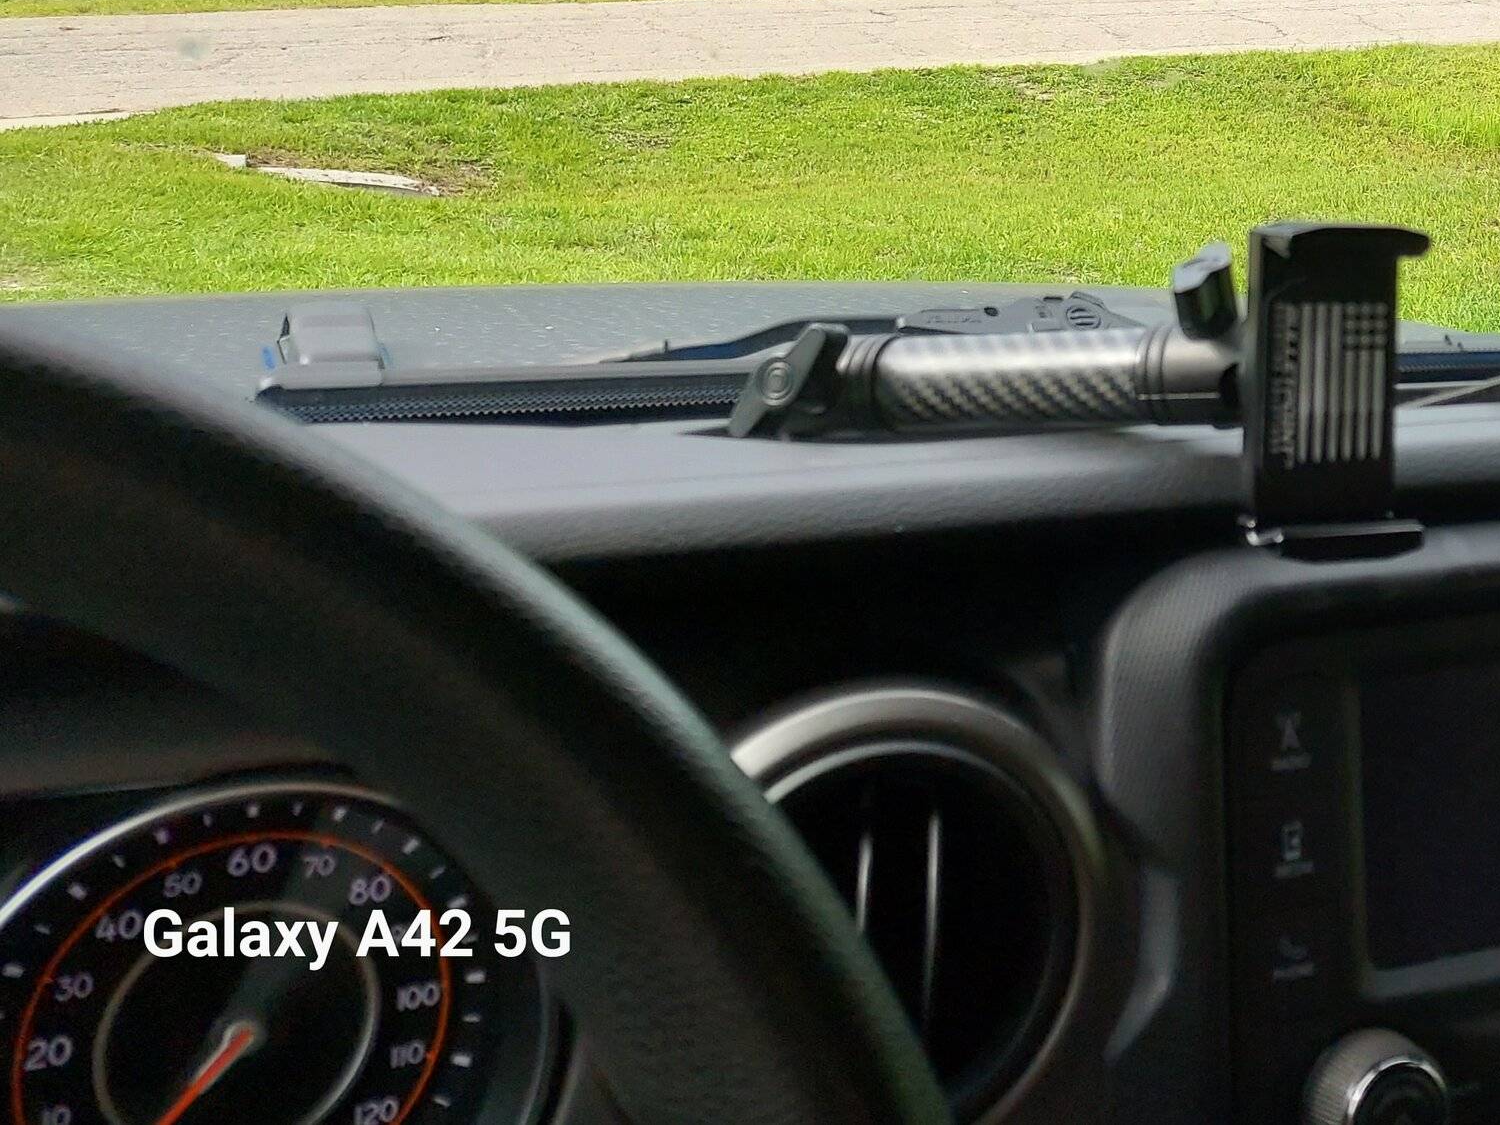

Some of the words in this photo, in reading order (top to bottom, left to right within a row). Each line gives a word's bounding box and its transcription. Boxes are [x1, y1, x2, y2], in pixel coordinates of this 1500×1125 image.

[228, 843, 277, 877] 60
[303, 854, 336, 878] 70
[164, 871, 201, 898] 50
[350, 874, 393, 906] 80
[96, 910, 144, 942] 40
[55, 973, 94, 1002] 30
[397, 982, 441, 1011] 100
[24, 1035, 73, 1071] 20
[354, 1095, 398, 1125] 120
